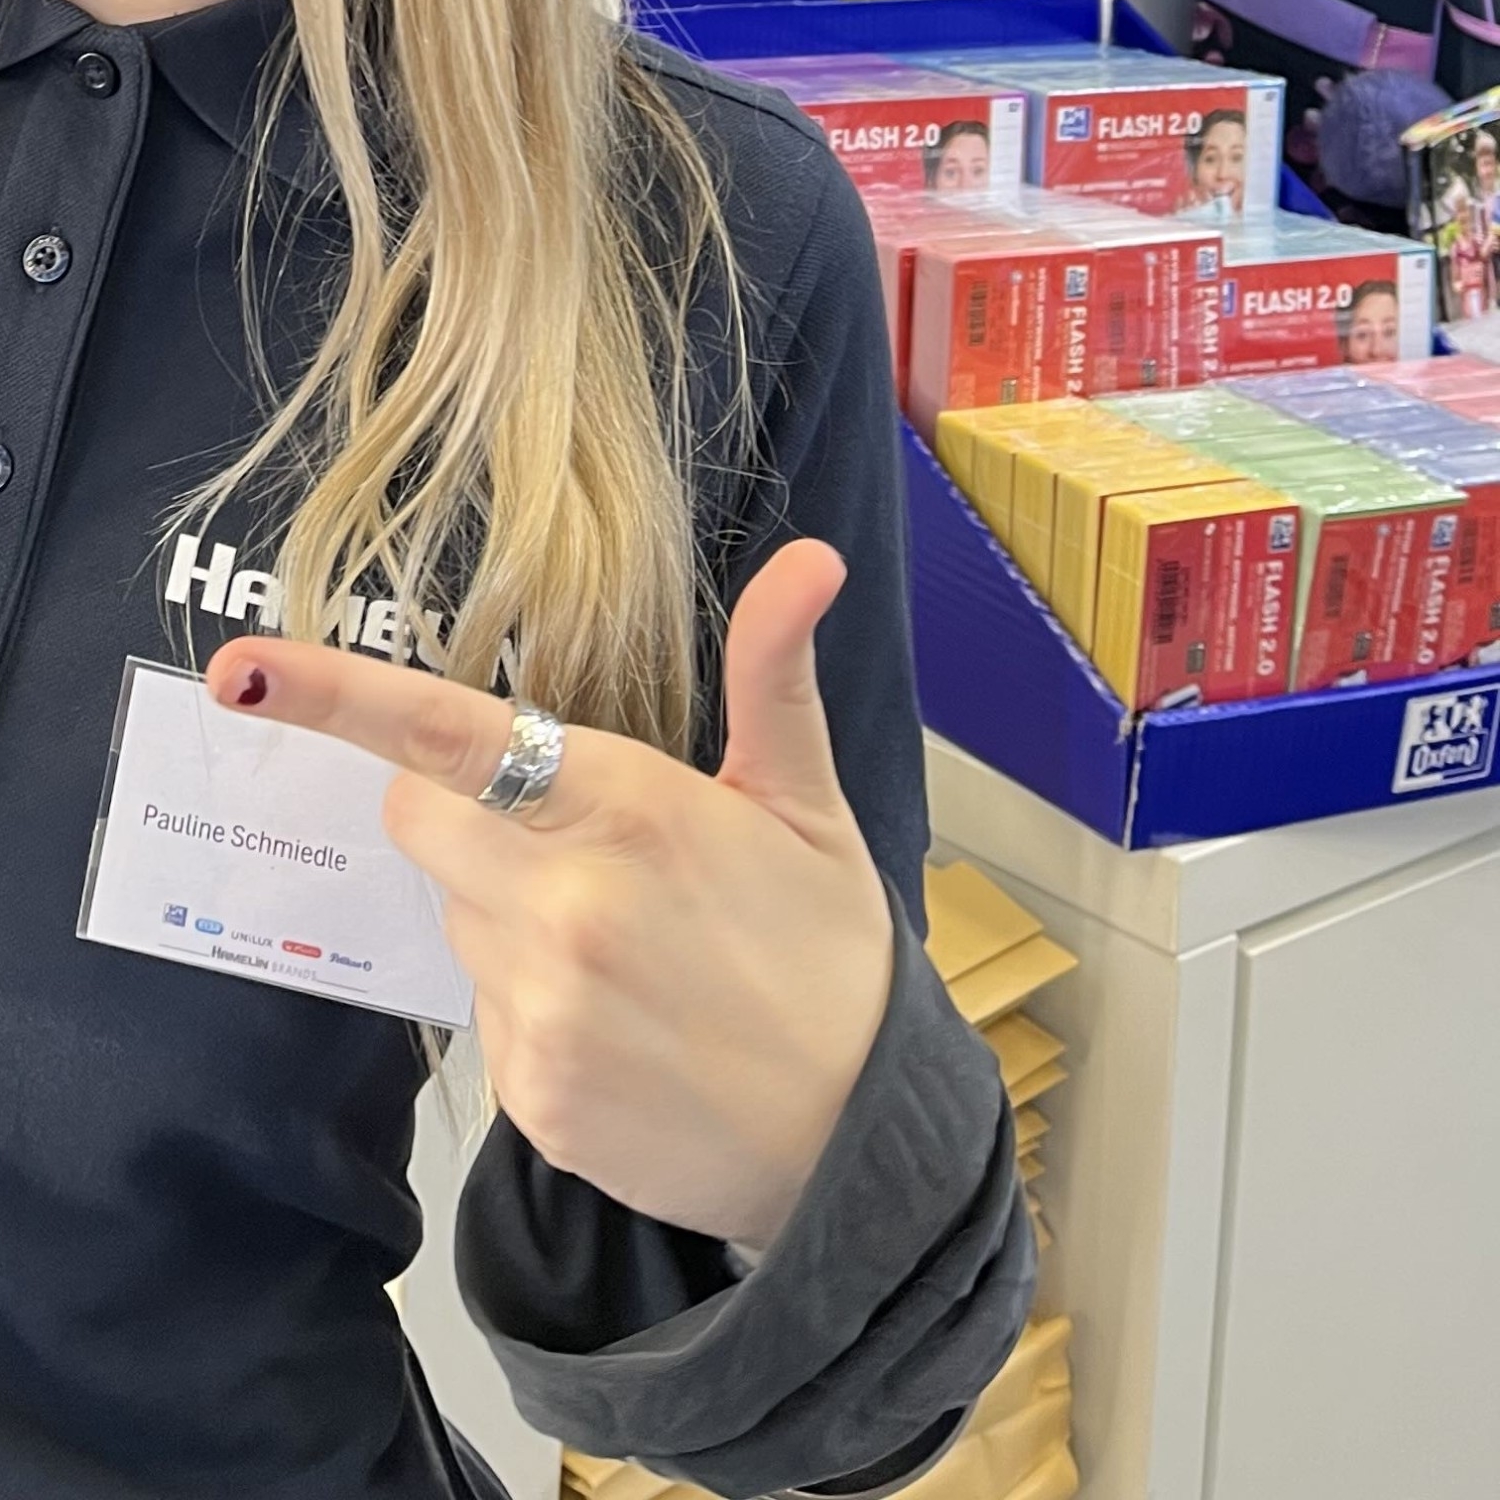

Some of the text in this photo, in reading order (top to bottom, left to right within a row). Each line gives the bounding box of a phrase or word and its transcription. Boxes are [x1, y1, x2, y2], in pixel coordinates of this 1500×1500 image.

[829, 123, 941, 151] FLASH 2.0
[1099, 113, 1164, 140] FLASH
[1168, 111, 1203, 136] 2.0
[1203, 286, 1219, 354] FLASH
[1243, 283, 1353, 315] FLASH 2.0
[1068, 306, 1087, 374] FLASH
[1256, 560, 1284, 676] FLASH 2.0
[1417, 555, 1451, 665] FLASH 2.0
[1411, 737, 1480, 776] Oxford
[143, 804, 348, 872] Pauline Schmiedle
